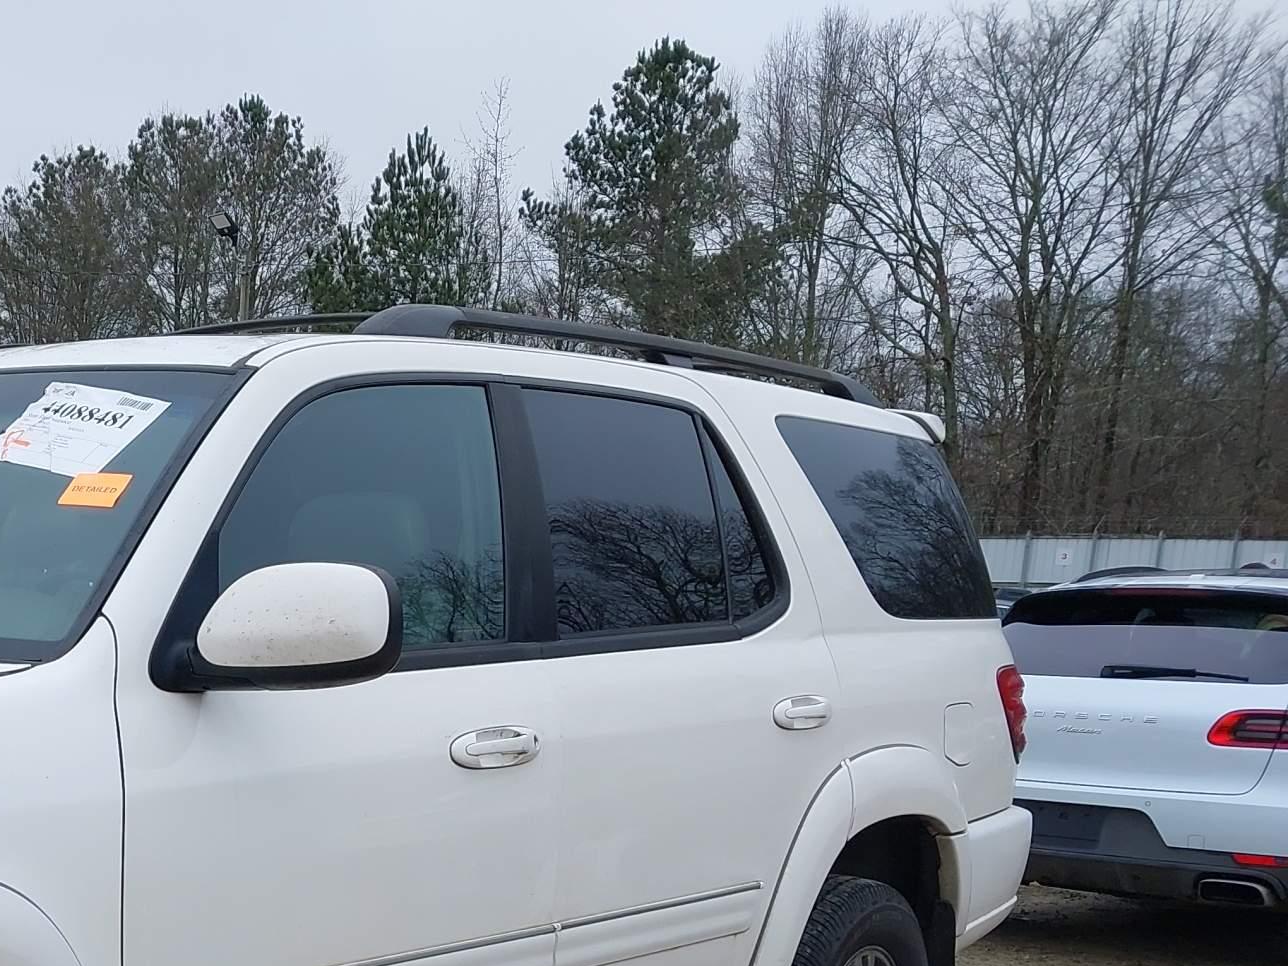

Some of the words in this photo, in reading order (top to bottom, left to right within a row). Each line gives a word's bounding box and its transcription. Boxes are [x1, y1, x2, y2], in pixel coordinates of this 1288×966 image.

[42, 401, 135, 430] 44088481
[71, 485, 118, 495] DETAILED
[1032, 710, 1160, 725] ORSCHE
